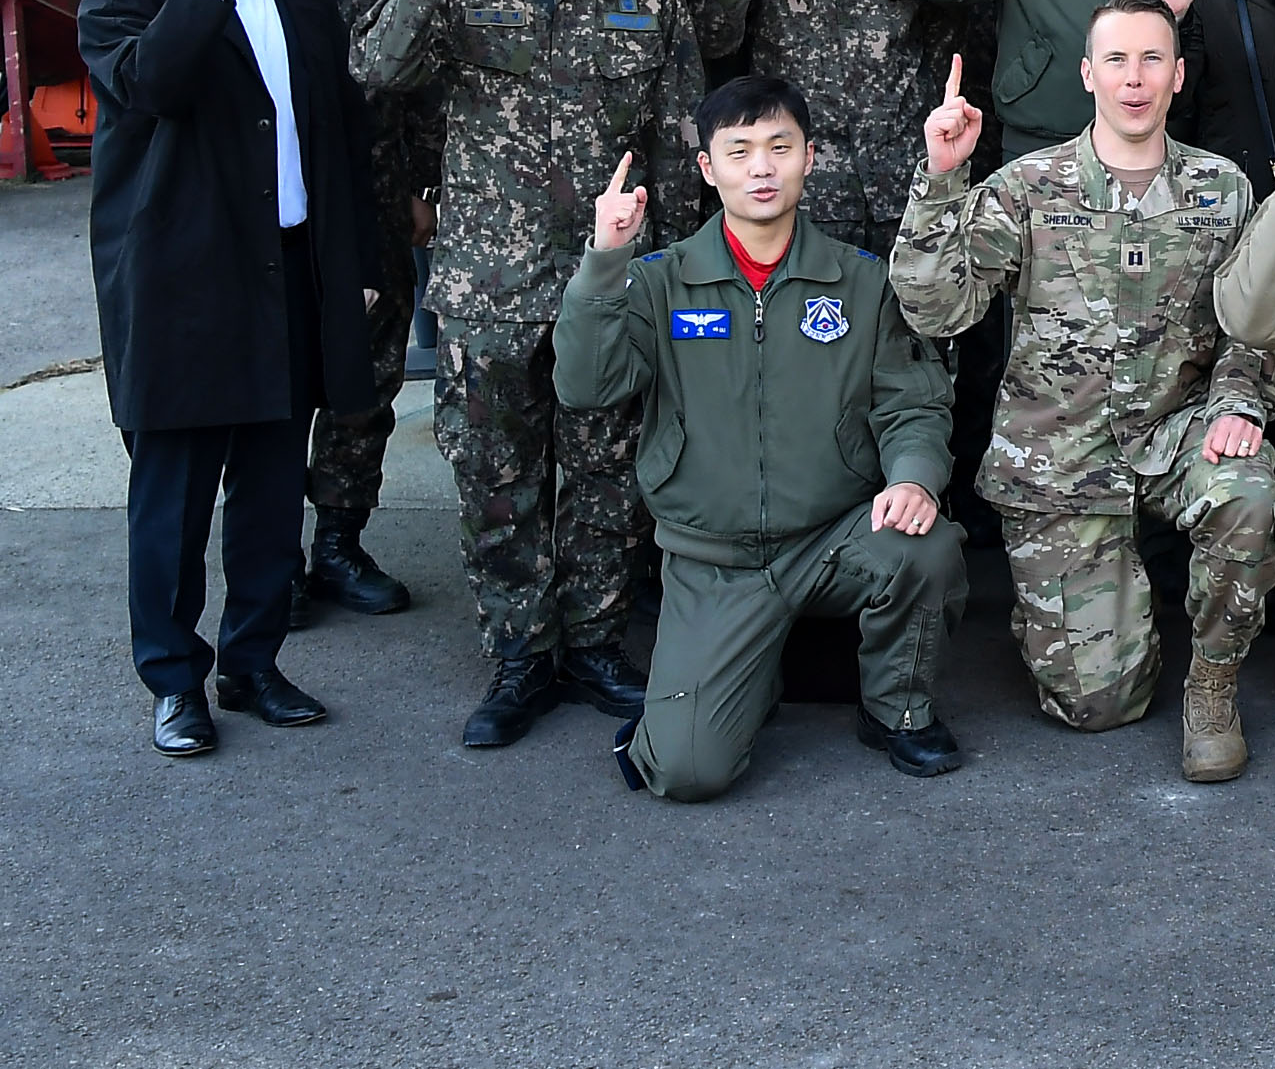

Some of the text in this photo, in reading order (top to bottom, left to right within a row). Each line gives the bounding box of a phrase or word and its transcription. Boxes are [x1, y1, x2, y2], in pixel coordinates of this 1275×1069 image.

[1042, 214, 1093, 227] SHERLOCK
[1192, 216, 1213, 227] SPACE
[1213, 217, 1233, 227] FORCE
